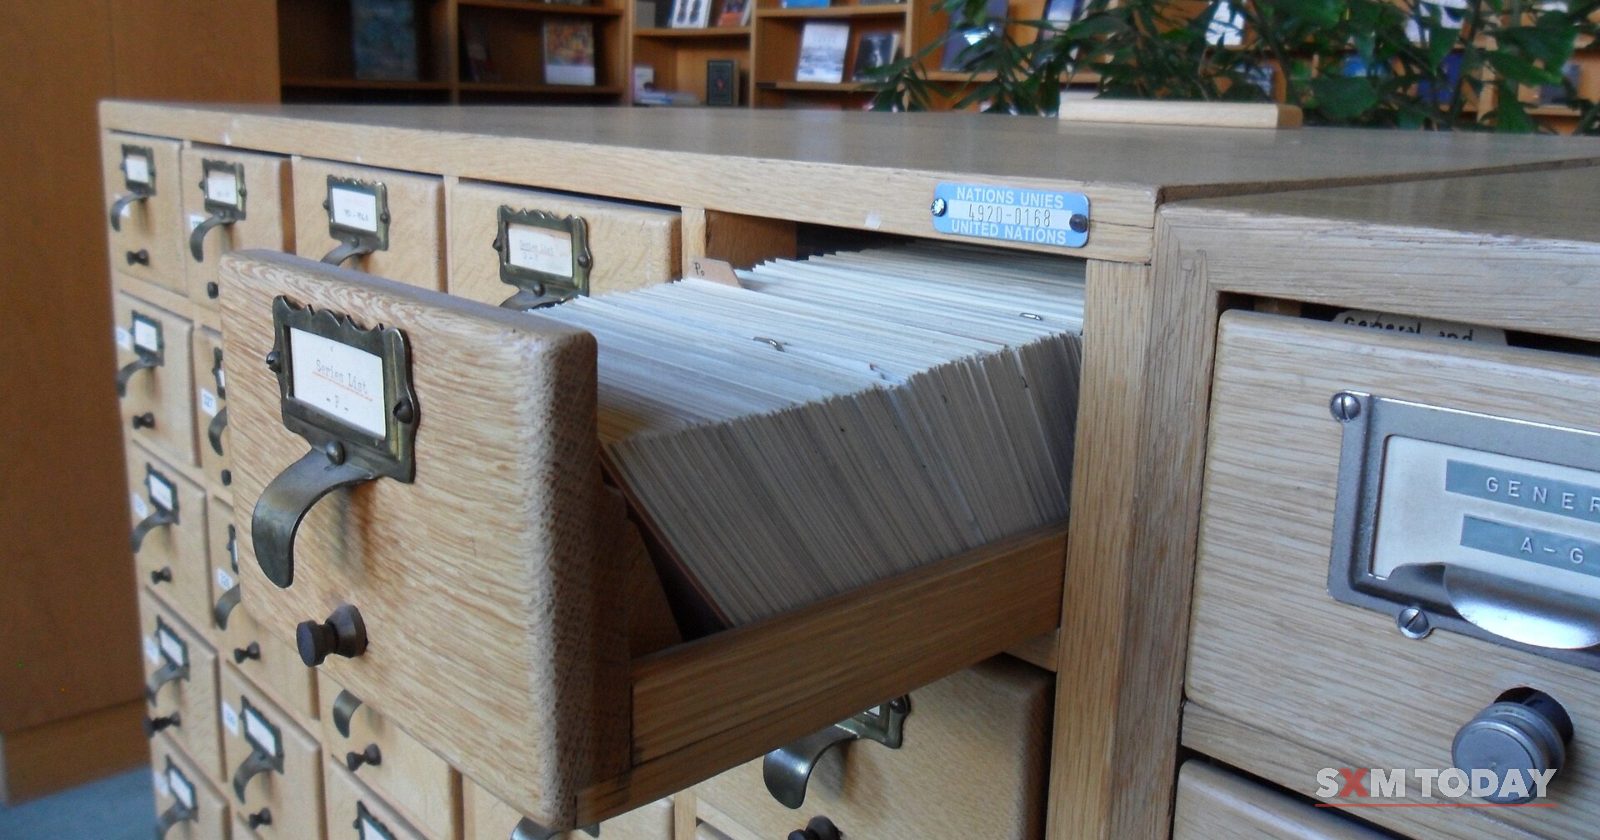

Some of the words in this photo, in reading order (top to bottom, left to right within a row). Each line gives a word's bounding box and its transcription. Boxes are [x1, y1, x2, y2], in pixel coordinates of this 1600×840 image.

[956, 187, 1015, 204] NATIONS
[1020, 193, 1065, 209] UNIES
[968, 204, 1051, 228] 4920-0168
[951, 219, 999, 238] UNITED
[1004, 224, 1067, 245] NATIONS
[348, 373, 367, 393] List
